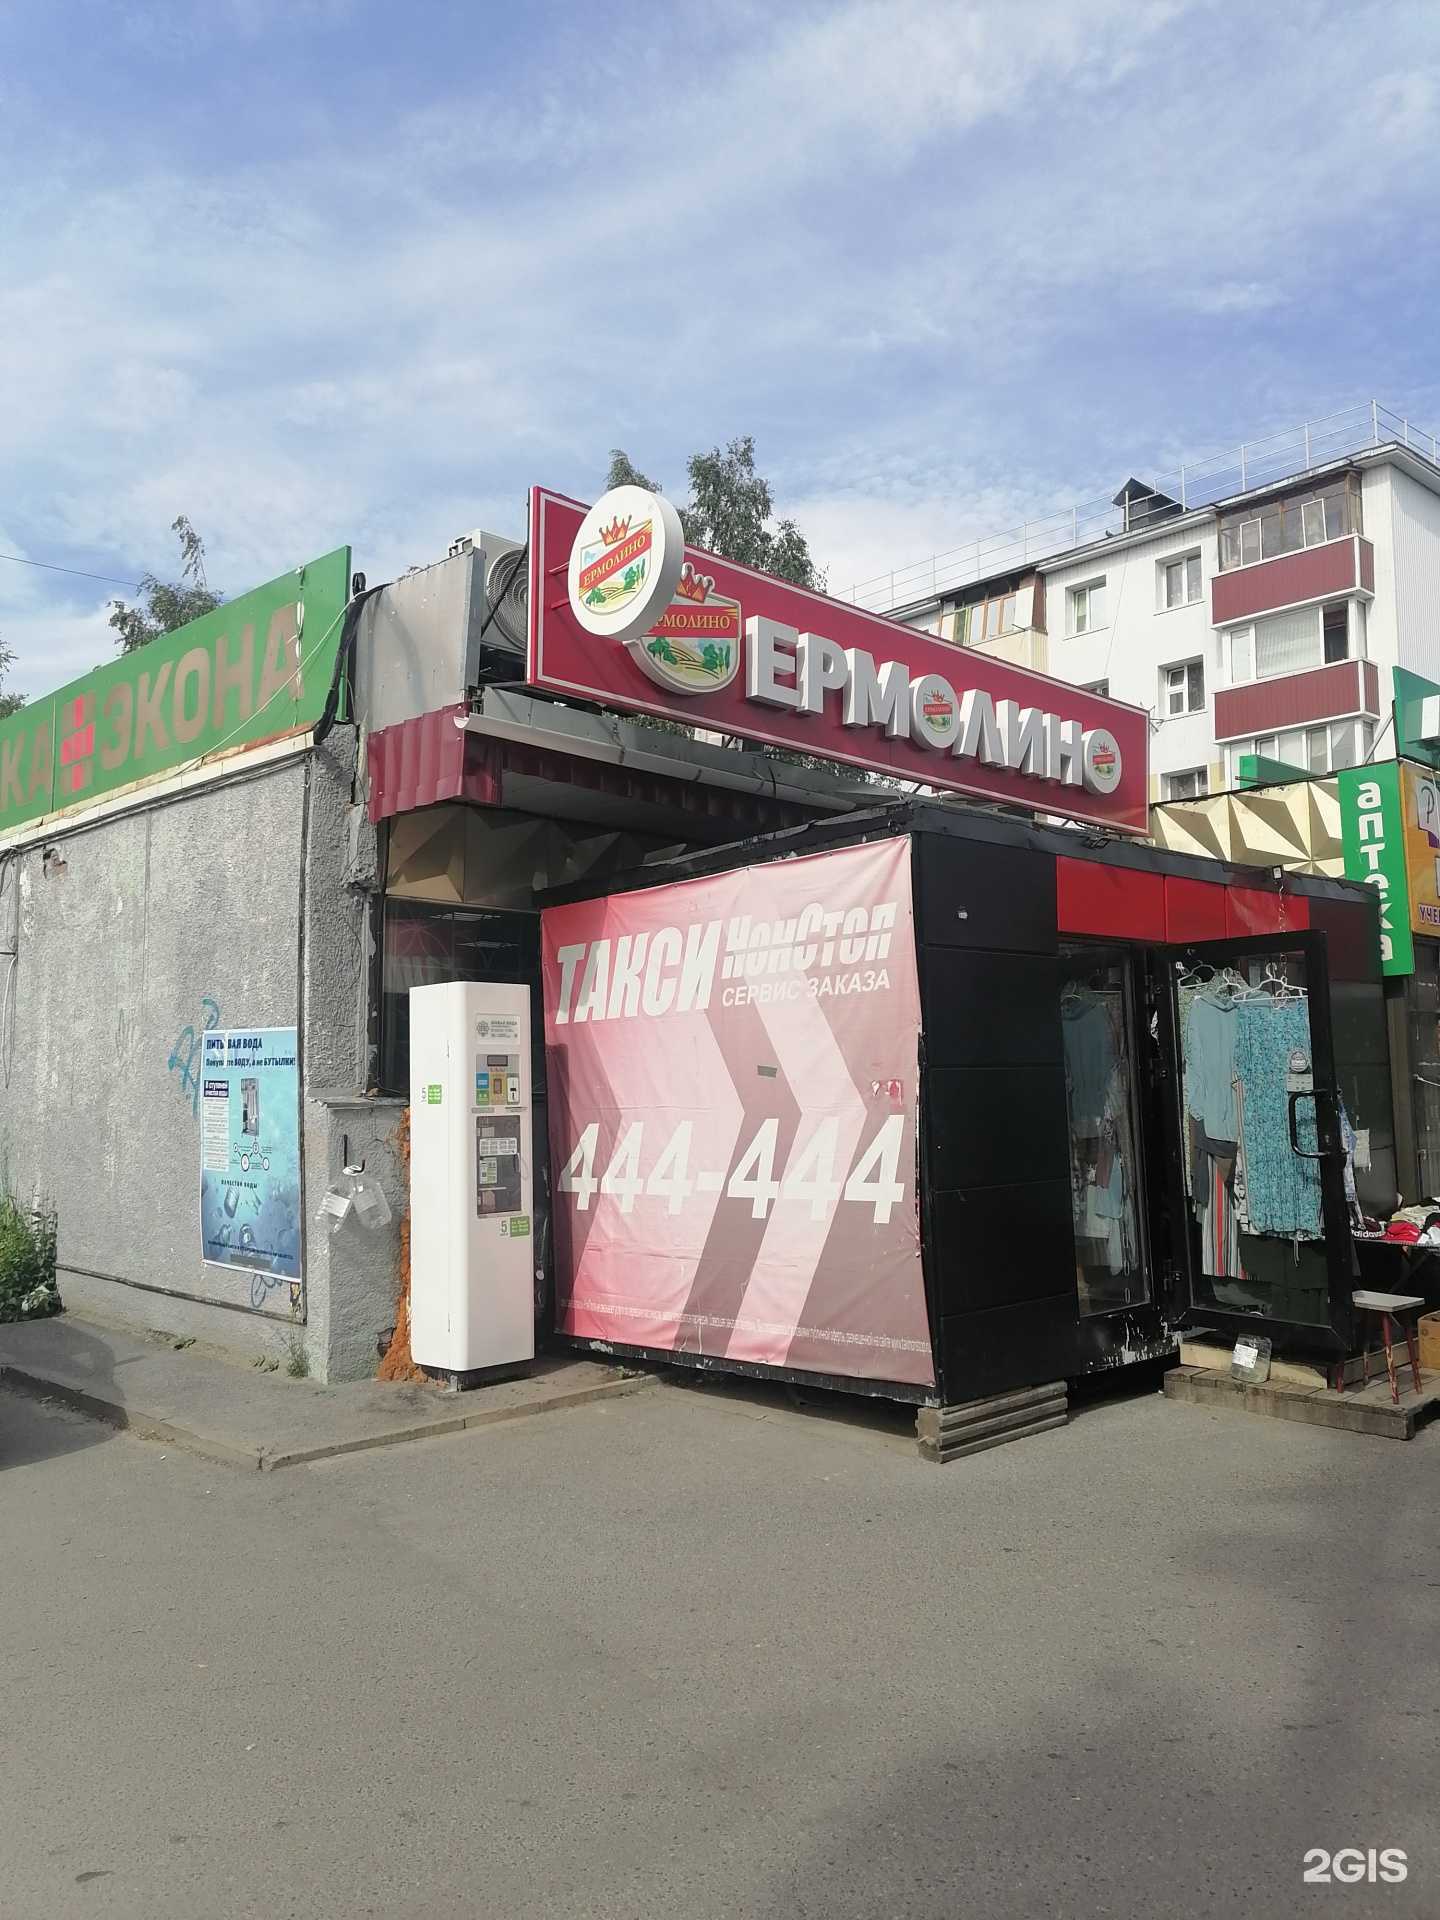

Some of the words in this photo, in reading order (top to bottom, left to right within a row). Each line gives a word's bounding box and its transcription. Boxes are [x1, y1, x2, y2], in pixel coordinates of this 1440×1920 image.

[583, 534, 647, 586] ЕРМОЛИНО
[656, 614, 731, 629] РМОЛИНО
[101, 601, 303, 771] ЭКОНА
[746, 615, 1121, 794] ЕРМОЛИНО
[1419, 905, 1440, 923] УЧЕ
[555, 920, 723, 1024] ТАКСИ
[722, 982, 801, 1007] СЕРВИС
[807, 968, 890, 997] ЗАКАЗА
[206, 1039, 241, 1049] ПИТЬВАЯ
[243, 1038, 263, 1051] ВОДА
[557, 1115, 905, 1224] 444-444
